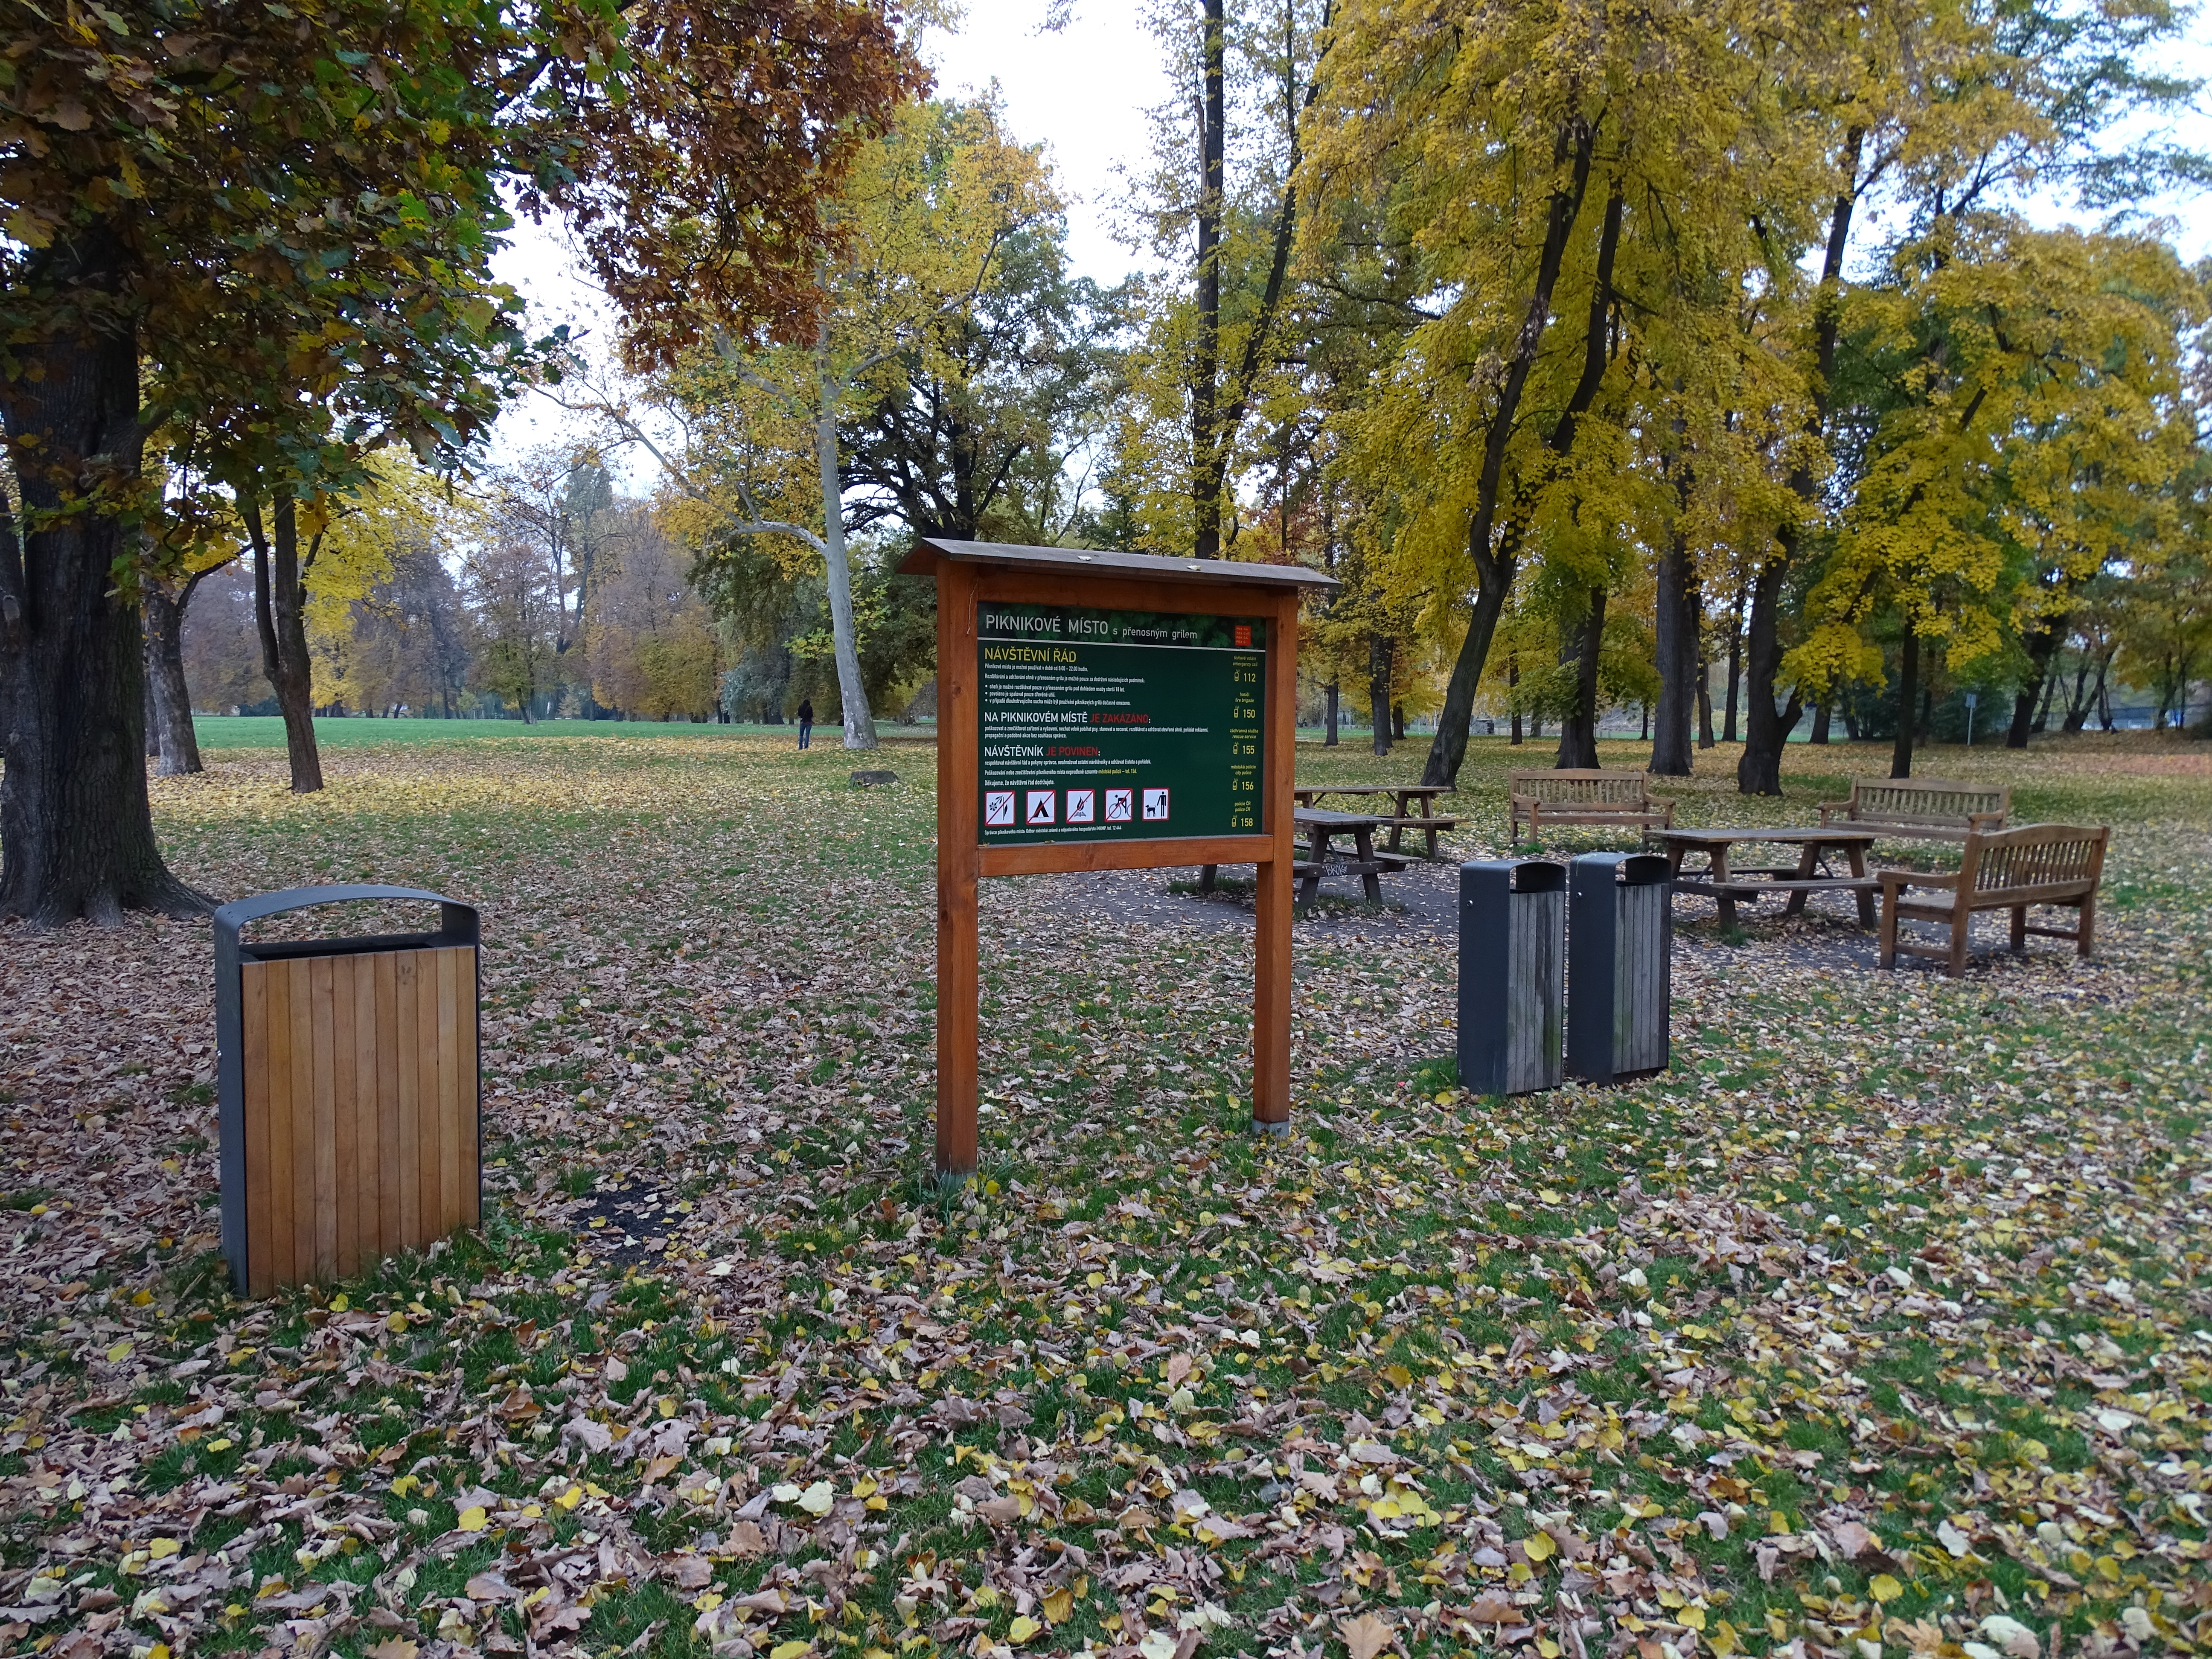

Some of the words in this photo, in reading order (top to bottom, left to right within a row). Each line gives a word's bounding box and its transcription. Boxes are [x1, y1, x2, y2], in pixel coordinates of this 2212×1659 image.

[986, 614, 1060, 632] PIKNIKOVÉ
[1068, 617, 1108, 634] MÍSTO
[1123, 627, 1167, 639] přenosným
[1172, 630, 1197, 640] grilem
[985, 646, 1050, 661] NÁVŠTĚVNÍ
[1054, 648, 1076, 663] ŘÁD
[1244, 673, 1256, 682] 112
[985, 712, 998, 722] NA
[1001, 711, 1058, 722] PIKNIKOVÉM
[1061, 711, 1087, 722] MÍSTĚ
[1090, 713, 1100, 723] JE
[1243, 709, 1255, 718] 150
[985, 745, 1044, 756] NÁVŠTĚVNÍK
[1045, 747, 1056, 756] JE
[1243, 745, 1254, 754] 155
[1242, 781, 1254, 790] 156
[1241, 818, 1253, 827] 158
